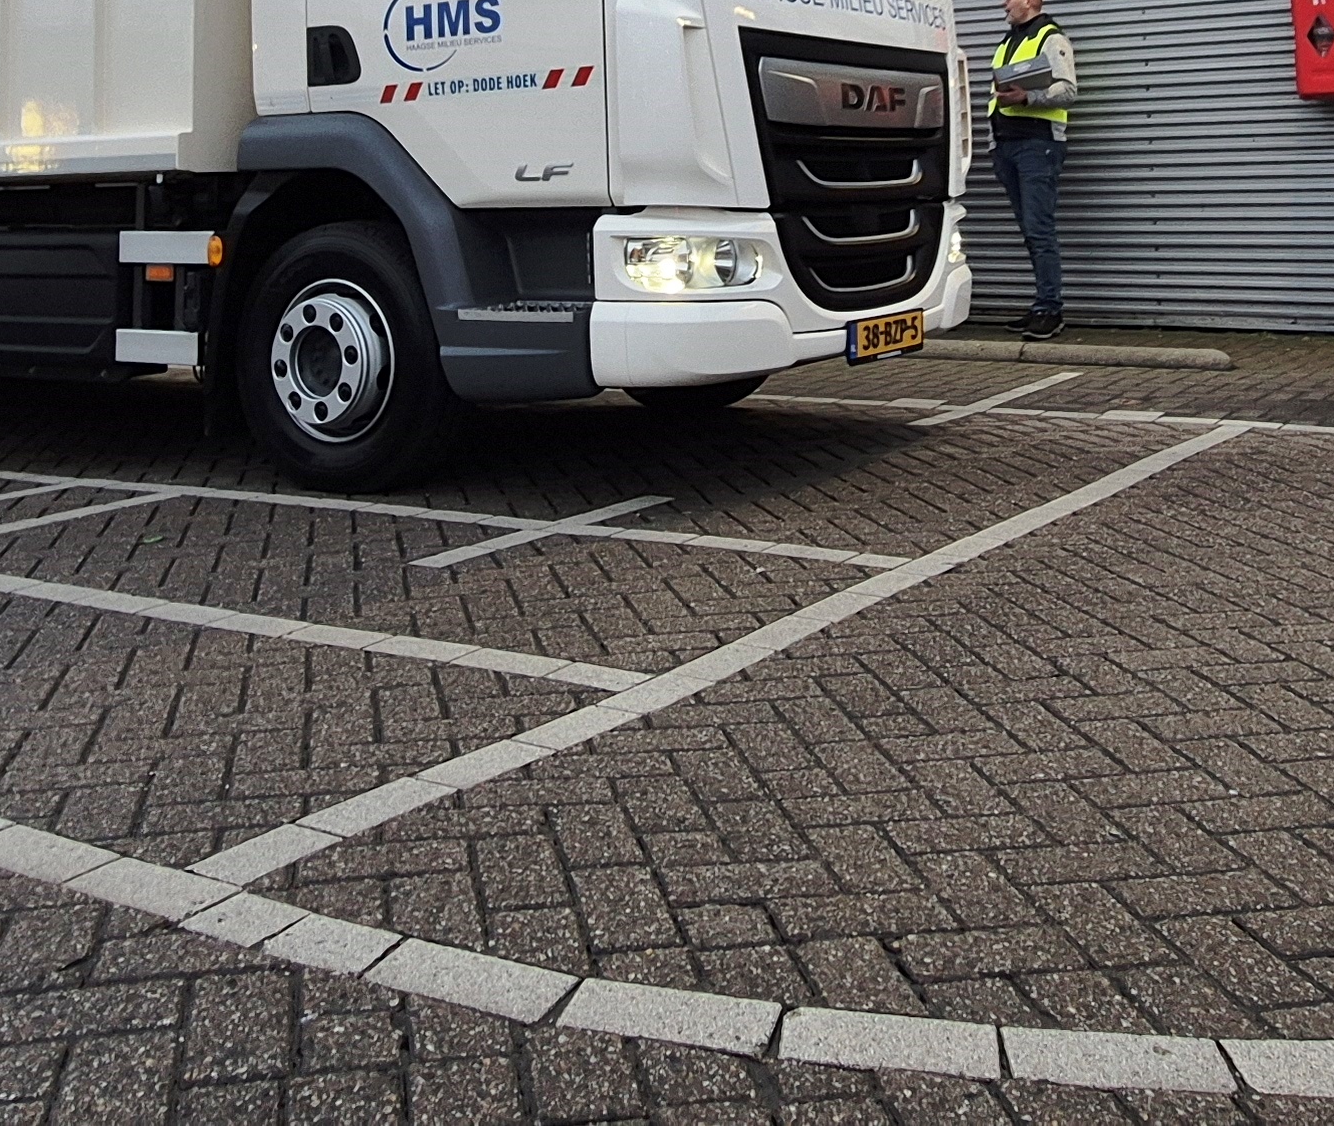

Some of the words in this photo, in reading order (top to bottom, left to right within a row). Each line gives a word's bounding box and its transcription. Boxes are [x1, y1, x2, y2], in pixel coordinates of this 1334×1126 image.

[407, 41, 435, 51] HAAGSE
[437, 38, 462, 48] MILIEU
[463, 34, 502, 46] SERVICES
[428, 81, 446, 96] LET
[450, 80, 469, 94] OP:
[473, 77, 503, 92] DODE
[506, 73, 537, 89] HOEK
[841, 83, 906, 112] DAF
[515, 163, 574, 182] LF
[862, 316, 919, 351] 38-BZP-5
